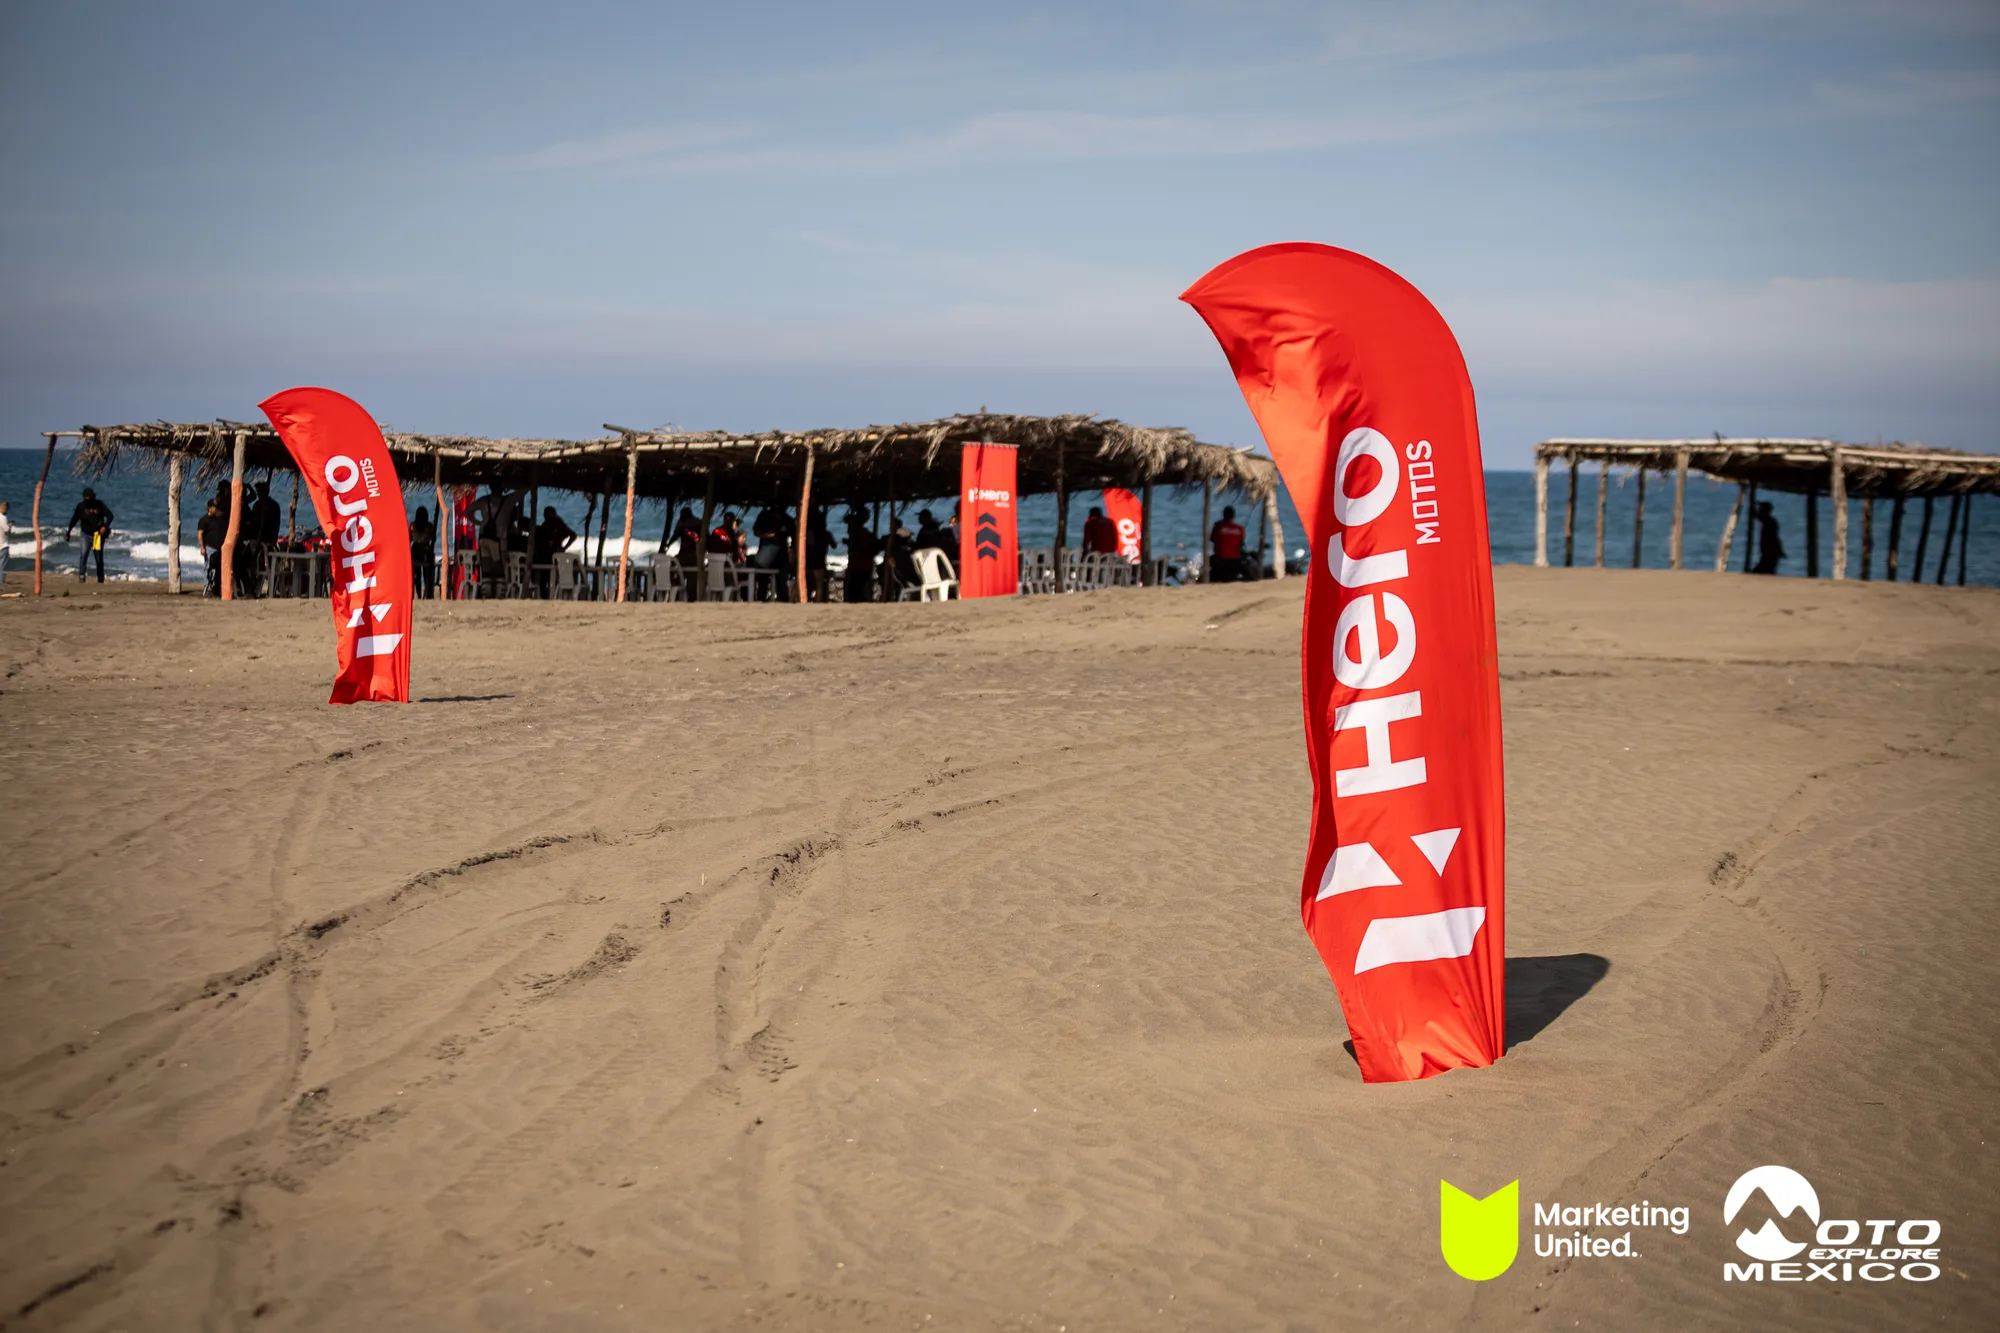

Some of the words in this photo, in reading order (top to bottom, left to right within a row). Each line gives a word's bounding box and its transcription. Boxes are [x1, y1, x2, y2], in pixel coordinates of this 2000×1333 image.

[324, 455, 377, 594] Hero
[360, 457, 380, 498] MOTOS
[1406, 439, 1441, 545] MOTOS
[1328, 426, 1427, 798] Hero
